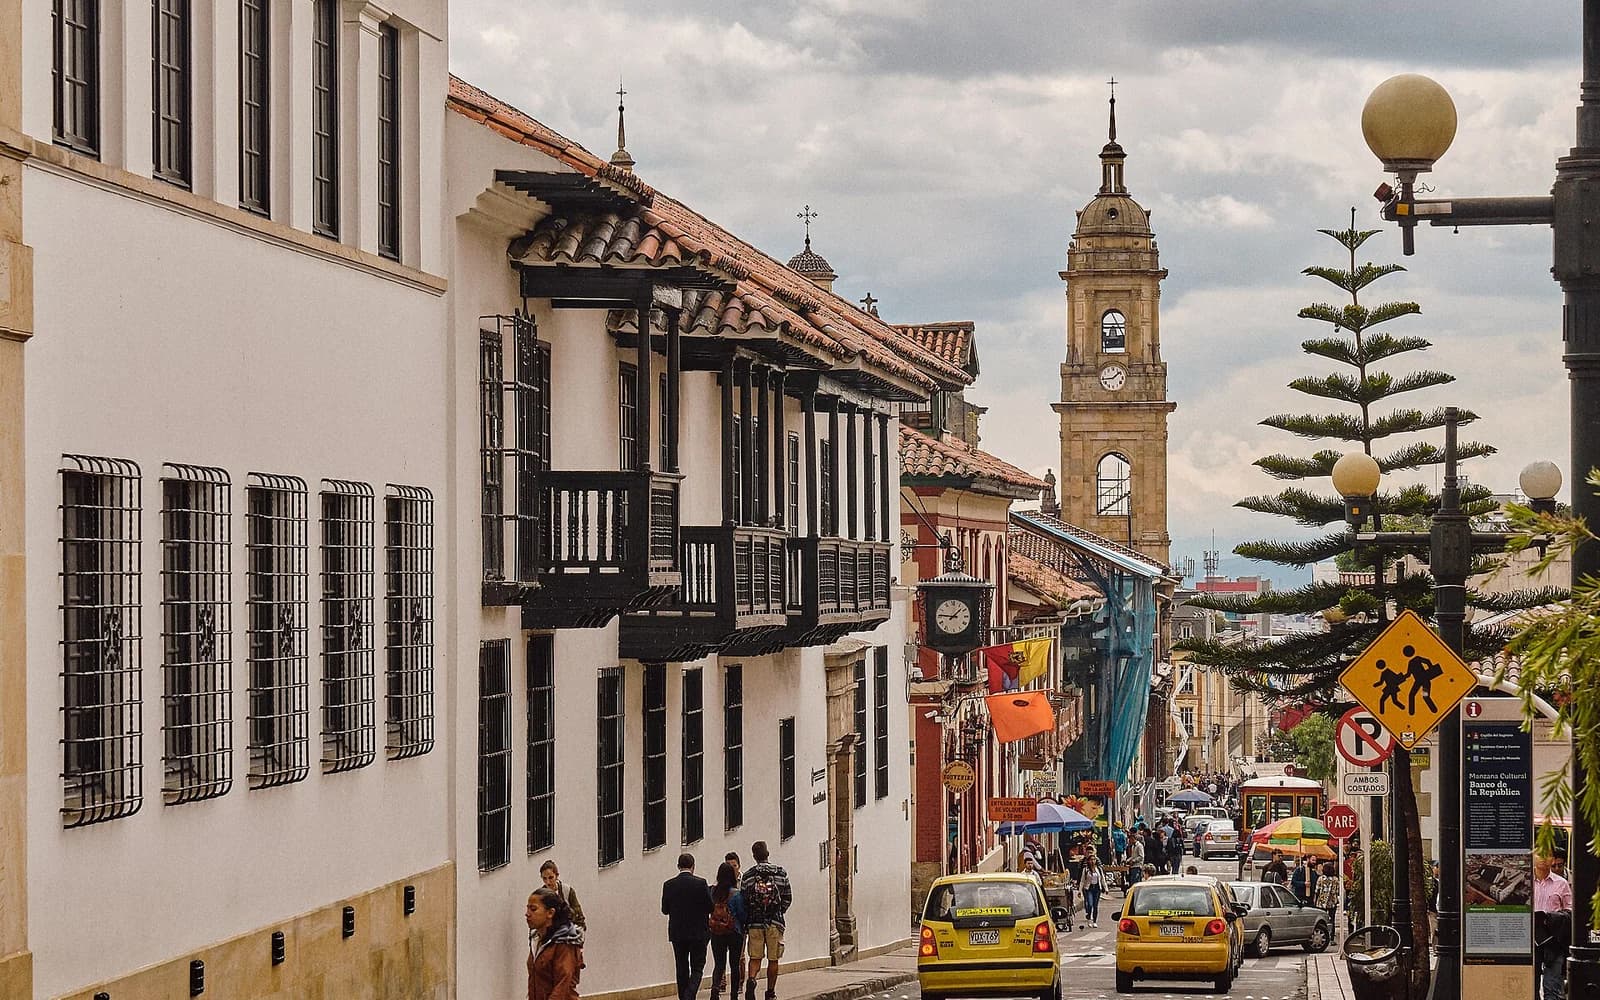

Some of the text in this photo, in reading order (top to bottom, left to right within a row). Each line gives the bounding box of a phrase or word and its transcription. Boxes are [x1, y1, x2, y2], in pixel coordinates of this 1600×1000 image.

[1353, 776, 1379, 784] AMBOS
[1500, 772, 1527, 780] Cultural
[1469, 788, 1521, 798] la República
[1327, 815, 1355, 828] PARE
